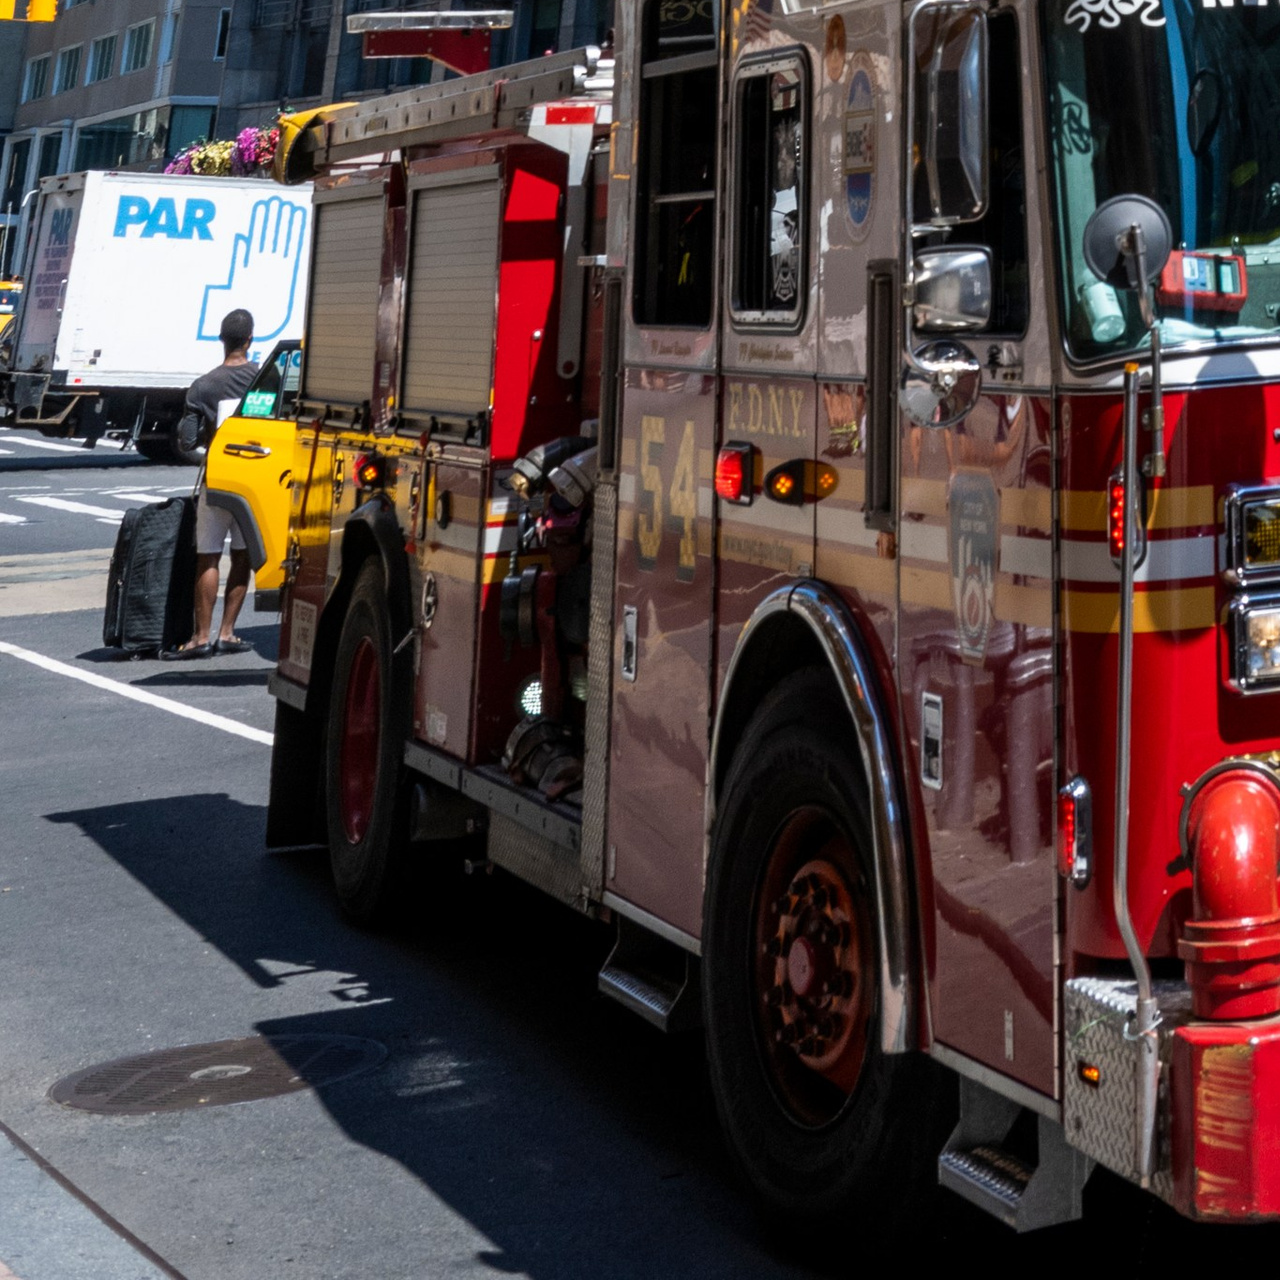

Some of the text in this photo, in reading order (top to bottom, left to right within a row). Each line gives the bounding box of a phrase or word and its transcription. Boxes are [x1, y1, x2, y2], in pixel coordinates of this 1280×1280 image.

[113, 195, 217, 241] PAR
[728, 382, 807, 438] F.D.N.Y.
[637, 415, 697, 569] 54
